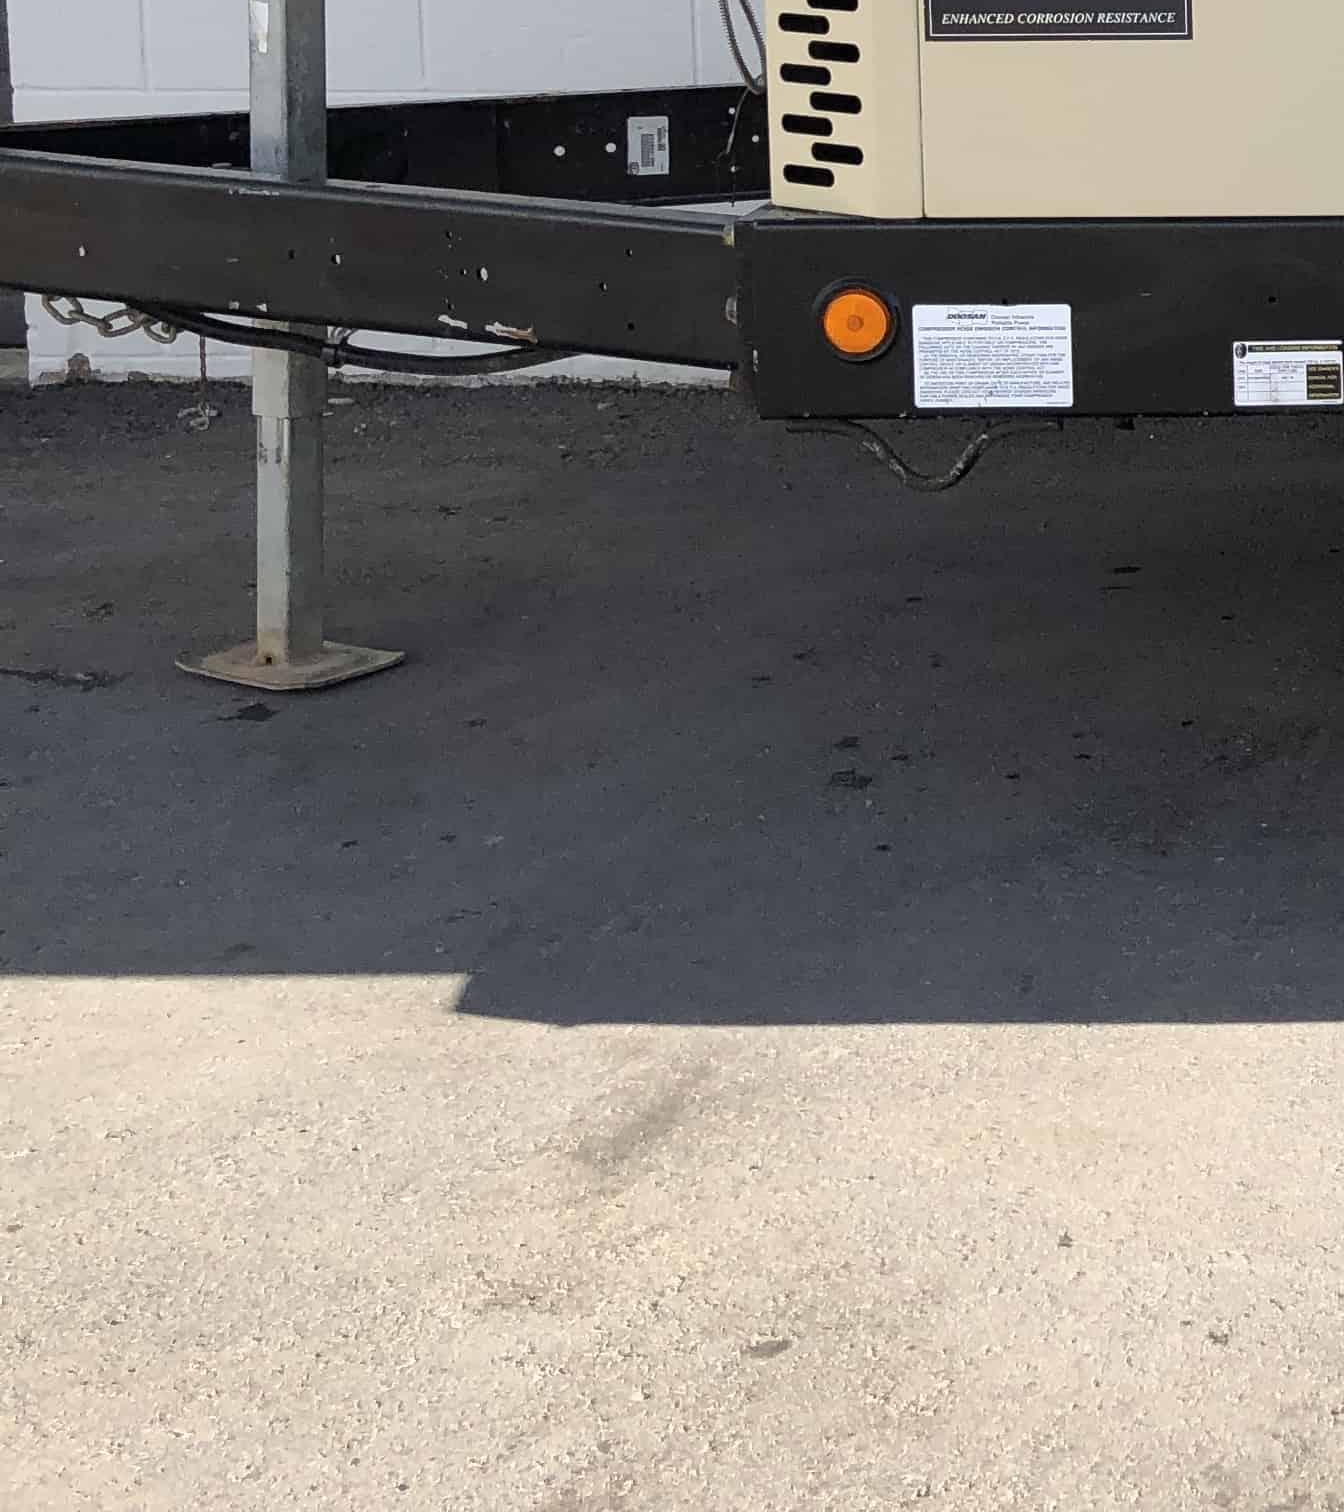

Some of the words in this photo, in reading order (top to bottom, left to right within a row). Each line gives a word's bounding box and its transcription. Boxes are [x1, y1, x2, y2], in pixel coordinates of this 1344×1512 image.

[941, 11, 1015, 25] ENHANCED
[1017, 11, 1095, 25] CORROSION
[1097, 11, 1177, 24] RESISTANCE
